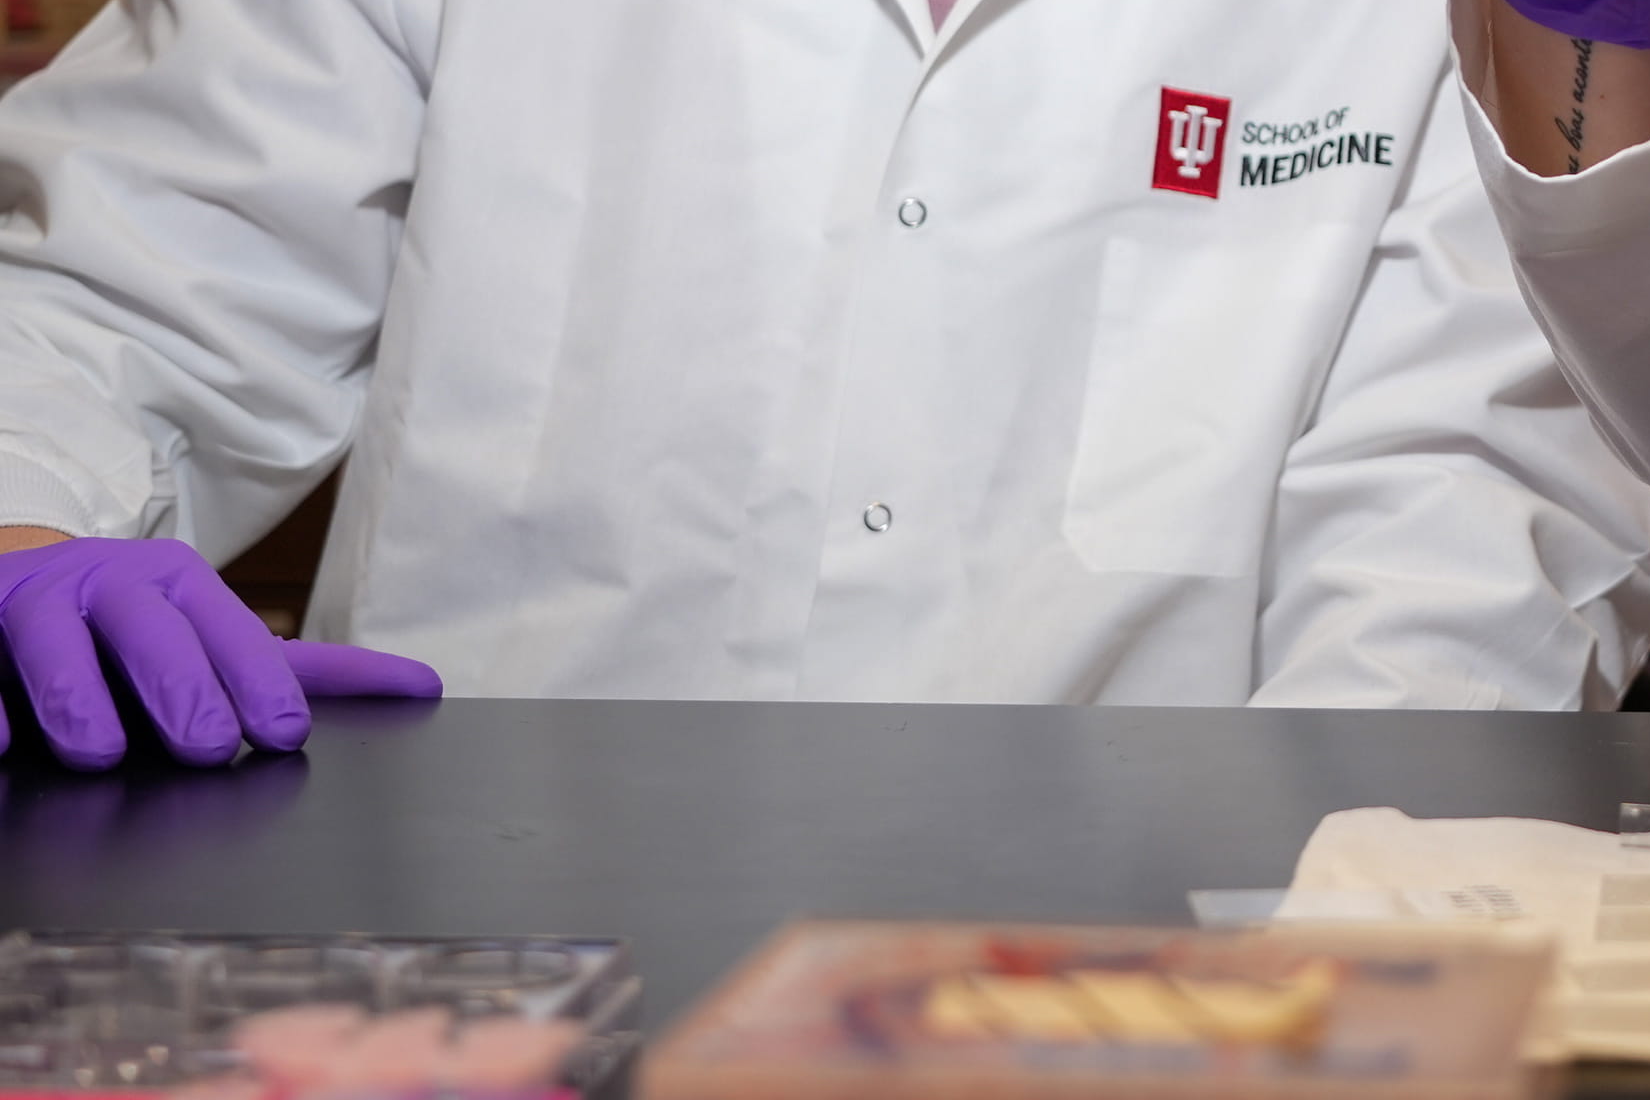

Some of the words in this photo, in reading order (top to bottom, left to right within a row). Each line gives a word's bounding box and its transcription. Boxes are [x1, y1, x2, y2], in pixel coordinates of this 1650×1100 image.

[1241, 117, 1319, 145] SCHOOL
[1325, 106, 1350, 130] OF
[1239, 132, 1395, 188] MEDICINE
